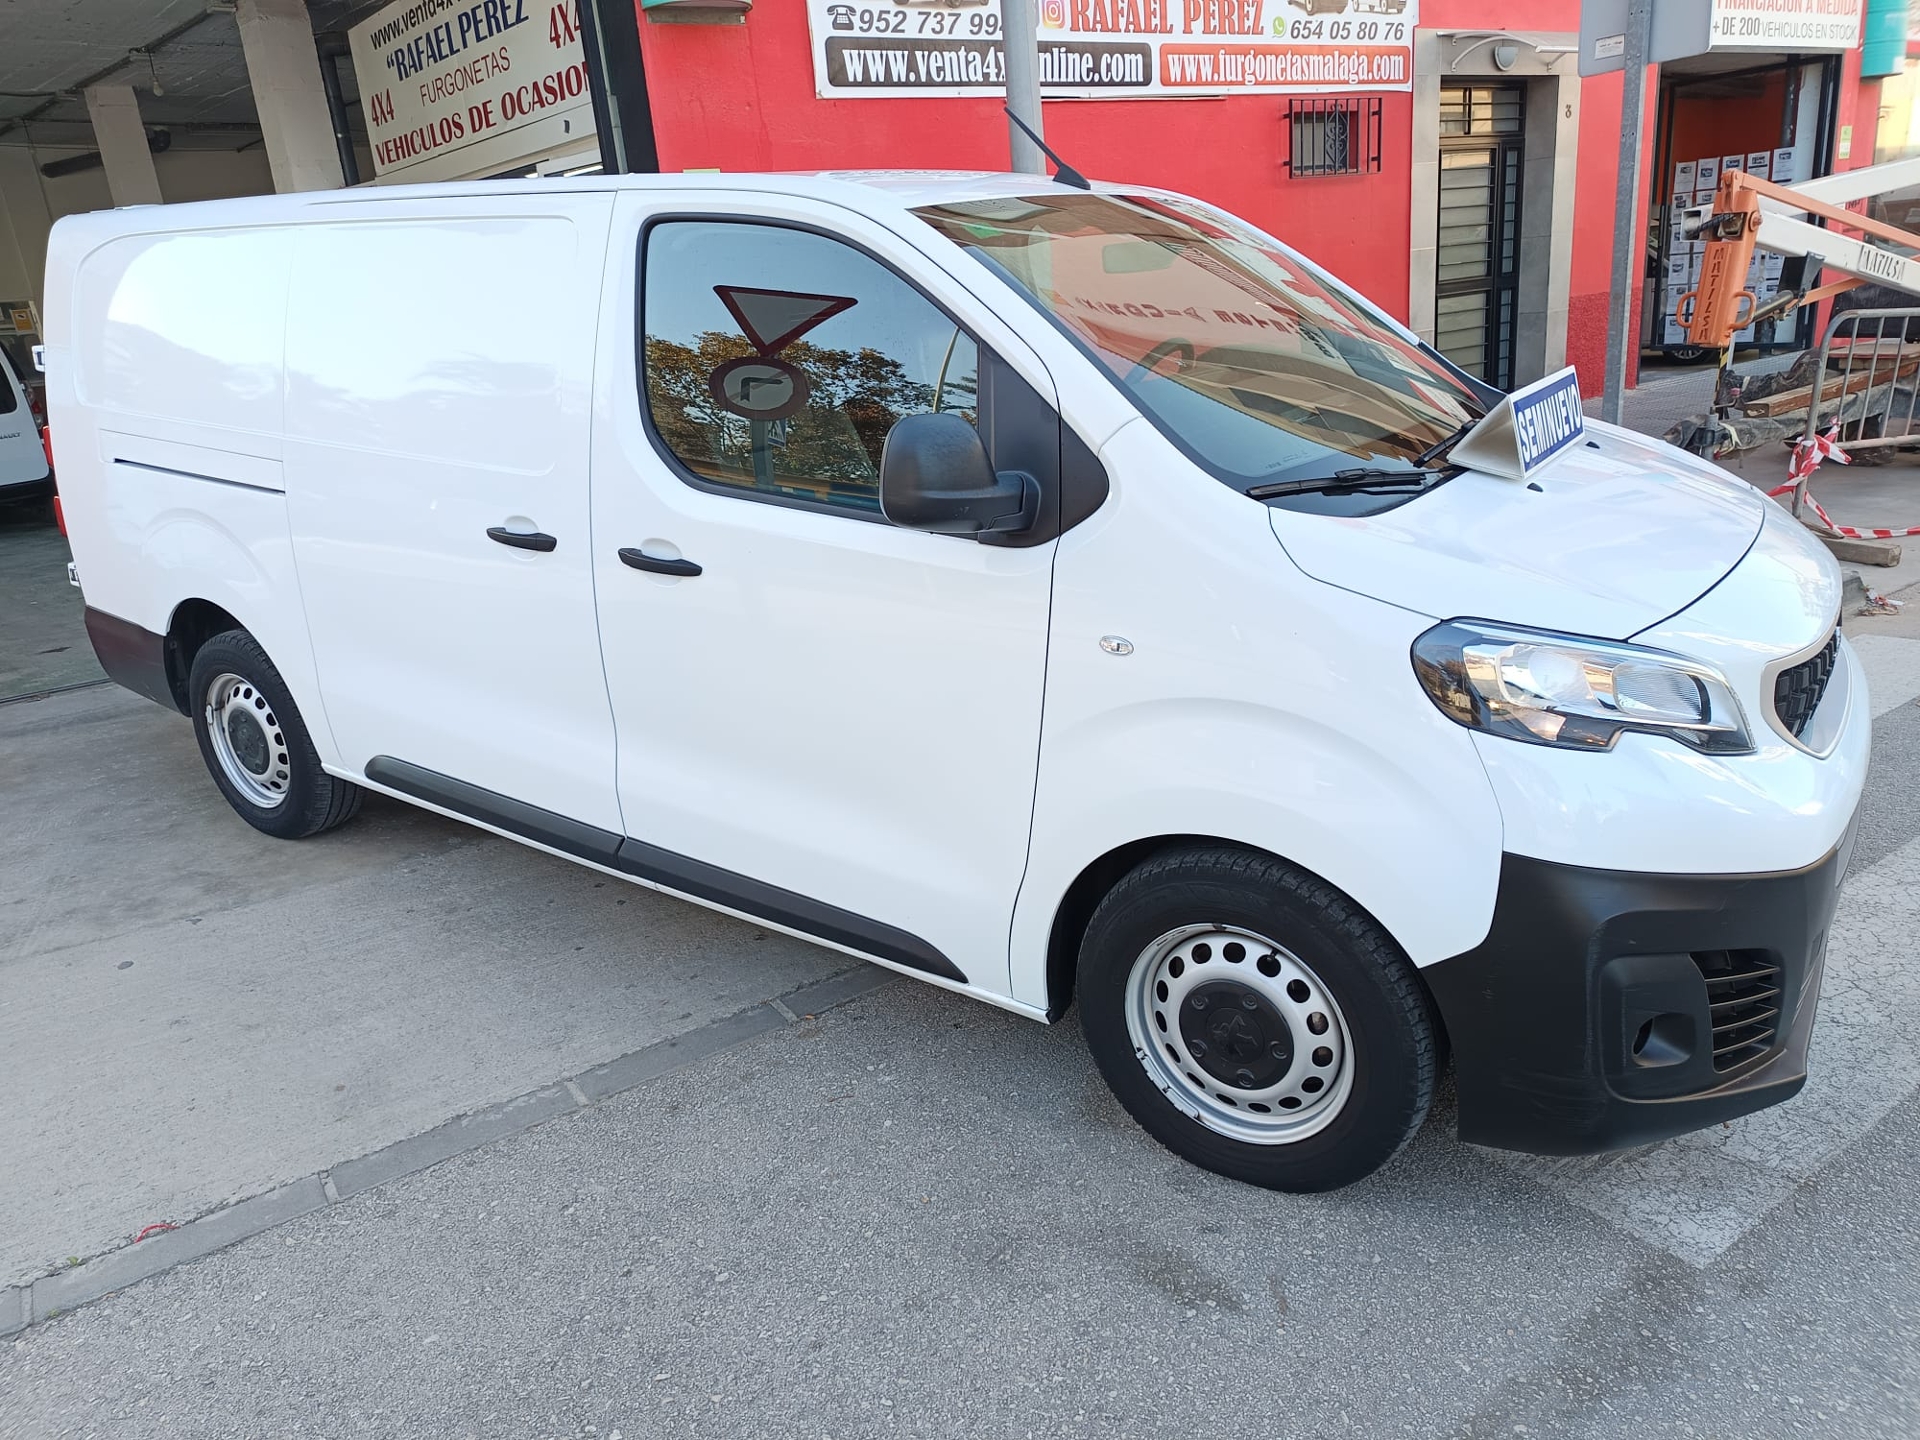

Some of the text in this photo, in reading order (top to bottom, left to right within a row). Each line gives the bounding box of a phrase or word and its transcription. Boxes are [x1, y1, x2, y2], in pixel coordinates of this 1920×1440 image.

[370, 0, 461, 50] www.venta4x
[457, 0, 529, 50] PEREZ
[858, 8, 1002, 36] 952 737 99
[1070, 0, 1265, 35] RAFAEL PEREZ
[1290, 19, 1404, 41] 654 05 80 76
[1722, 16, 1736, 36] DE
[1739, 16, 1760, 36] 200
[1761, 21, 1814, 38] VEHICULOS
[1815, 23, 1828, 39] EN
[1829, 23, 1857, 40] STOCK
[419, 46, 511, 107] FURGONETAS
[842, 45, 1144, 83] www.venta4xnline.com
[1166, 49, 1404, 85] www.furgonetasmalaga.com
[371, 88, 395, 127] 4X4
[375, 112, 465, 166] VEHICULOS
[468, 99, 497, 134] DE
[1517, 383, 1582, 464] SEMINUEVO
